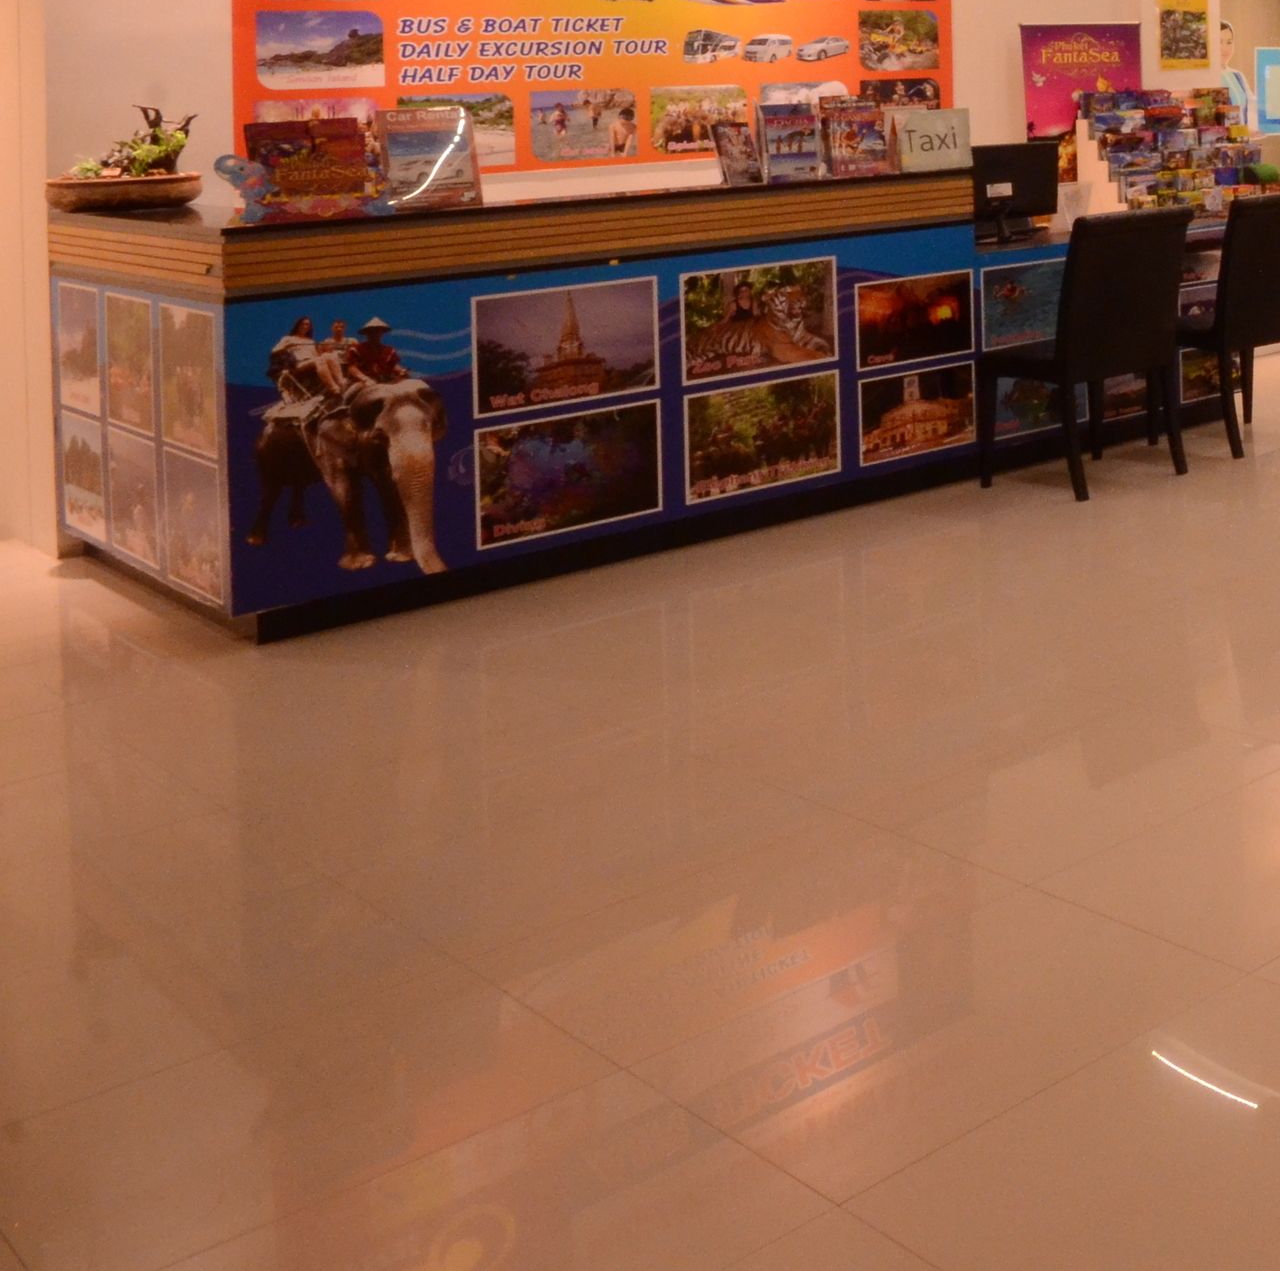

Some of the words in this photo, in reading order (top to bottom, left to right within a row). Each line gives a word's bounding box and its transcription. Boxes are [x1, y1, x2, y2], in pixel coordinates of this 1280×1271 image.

[400, 18, 447, 34] BUS
[457, 19, 472, 34] &
[482, 18, 542, 33] BOAT
[551, 17, 624, 32] TICKET
[400, 42, 469, 59] DAILY
[479, 41, 602, 57] EXCURSION
[614, 39, 668, 55] TOUR
[1041, 48, 1120, 64] FantaSea
[401, 67, 460, 83] HALF
[470, 65, 516, 81] DAY
[525, 64, 582, 80] TOUR
[386, 110, 413, 122] Car
[416, 109, 462, 119] Renta
[905, 126, 958, 153] Taxi
[489, 392, 525, 408] Wat
[530, 382, 600, 402] Chalong
